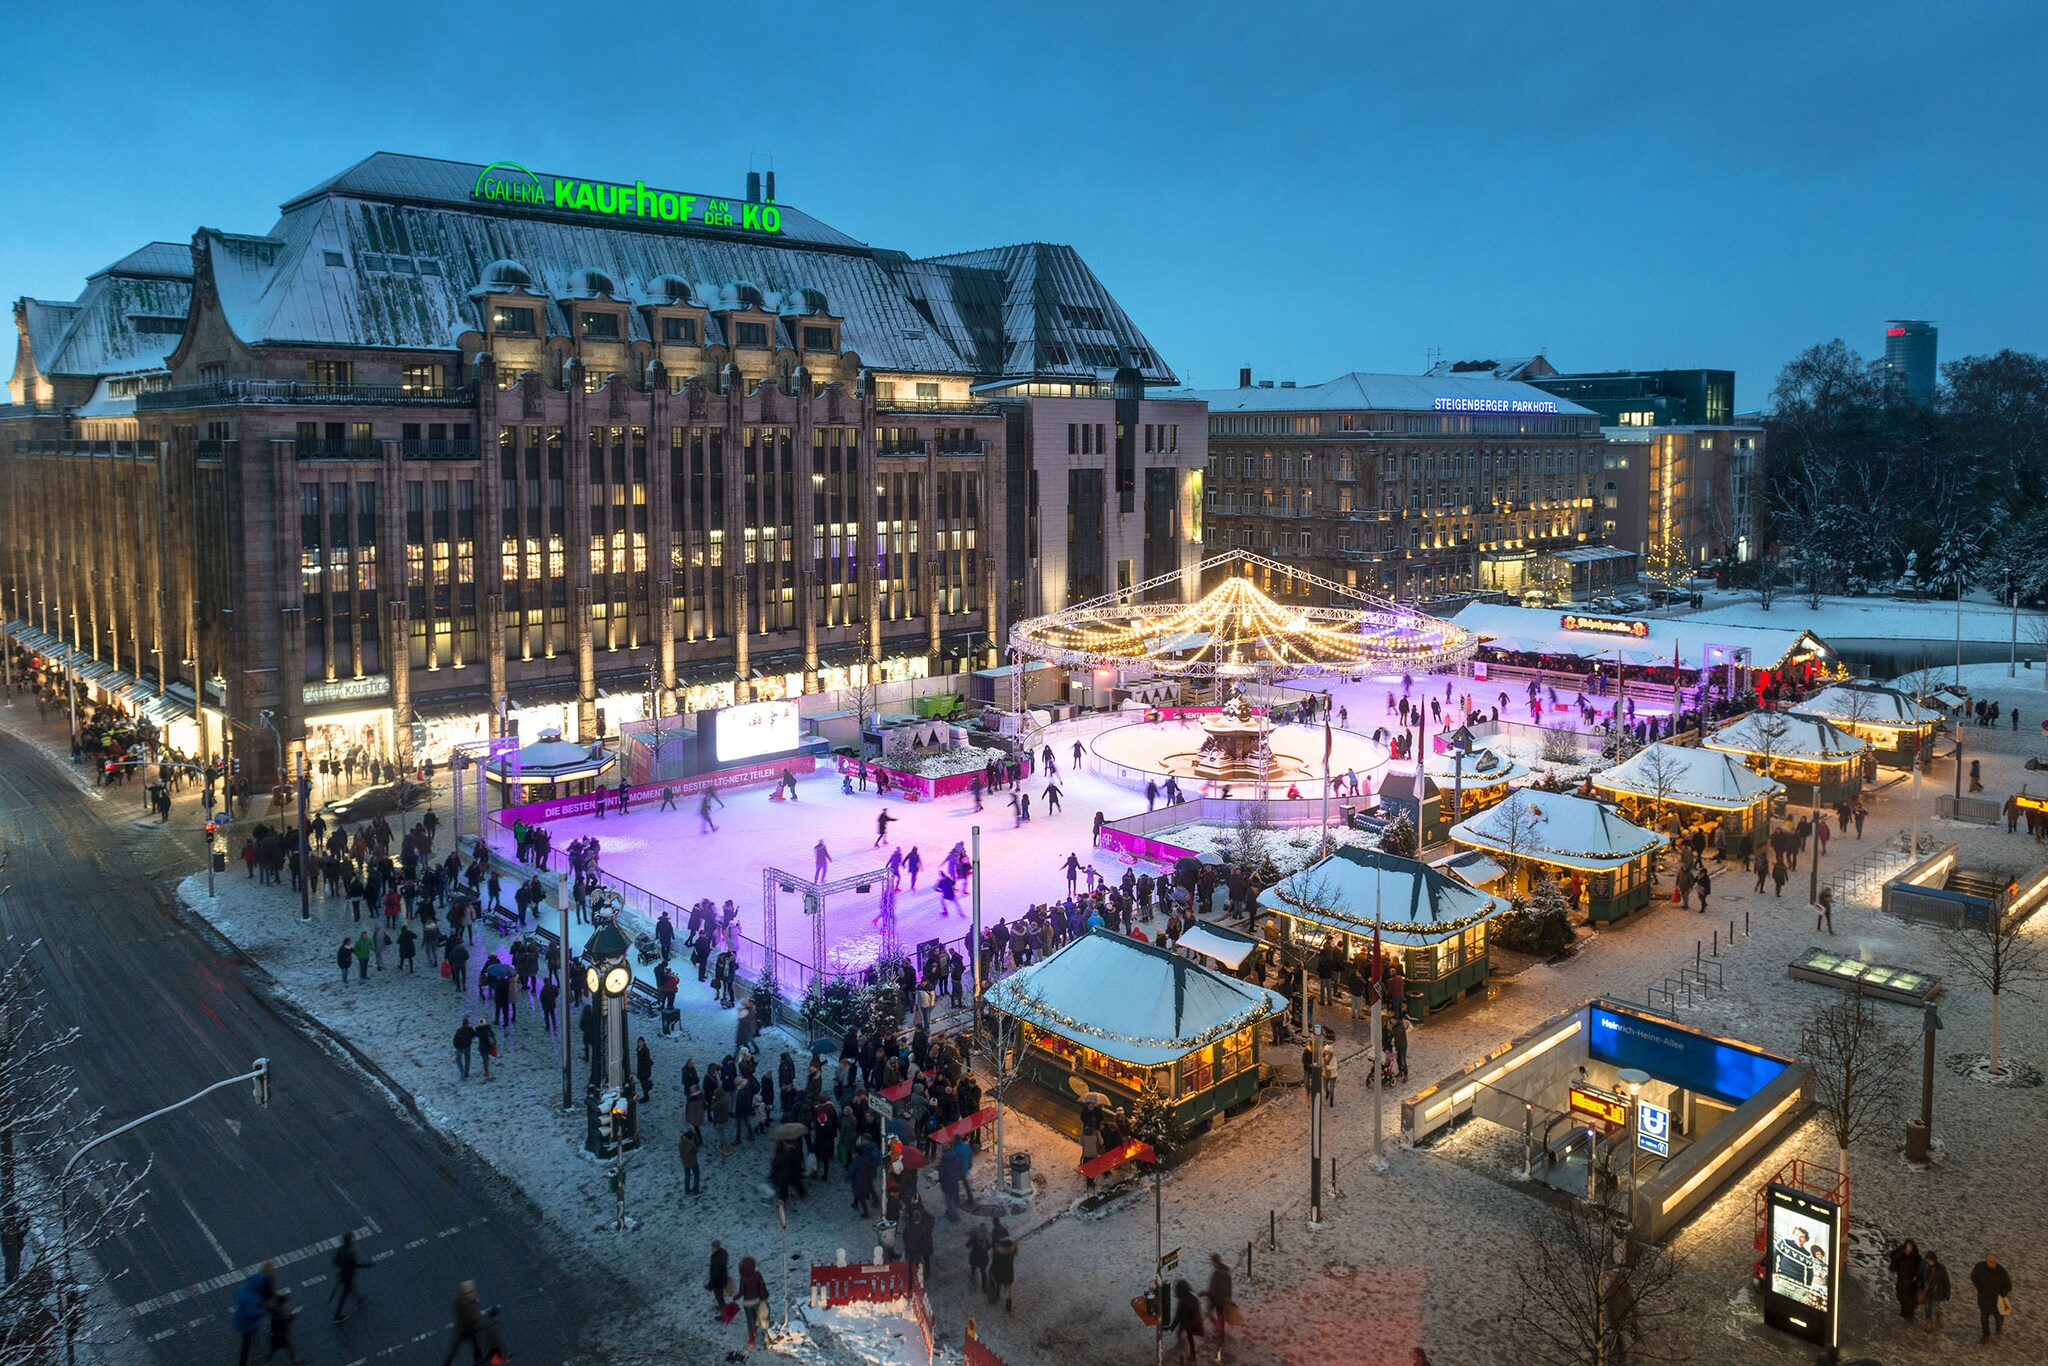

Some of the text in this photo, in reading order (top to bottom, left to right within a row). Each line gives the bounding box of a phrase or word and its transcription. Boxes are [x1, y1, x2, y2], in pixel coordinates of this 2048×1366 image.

[484, 177, 545, 205] GALERIA
[704, 212, 733, 227] DER
[708, 199, 729, 213] AN
[742, 198, 781, 233] KÖ
[1434, 397, 1559, 413] STEIGENBERGER PARKHOTEL
[545, 806, 561, 818] DIE
[562, 800, 596, 815] BESTEN
[714, 772, 749, 787] LTE-NETZ
[750, 767, 775, 780] TEILEN
[1601, 1017, 1686, 1051] Heinrich-Heine-Allee
